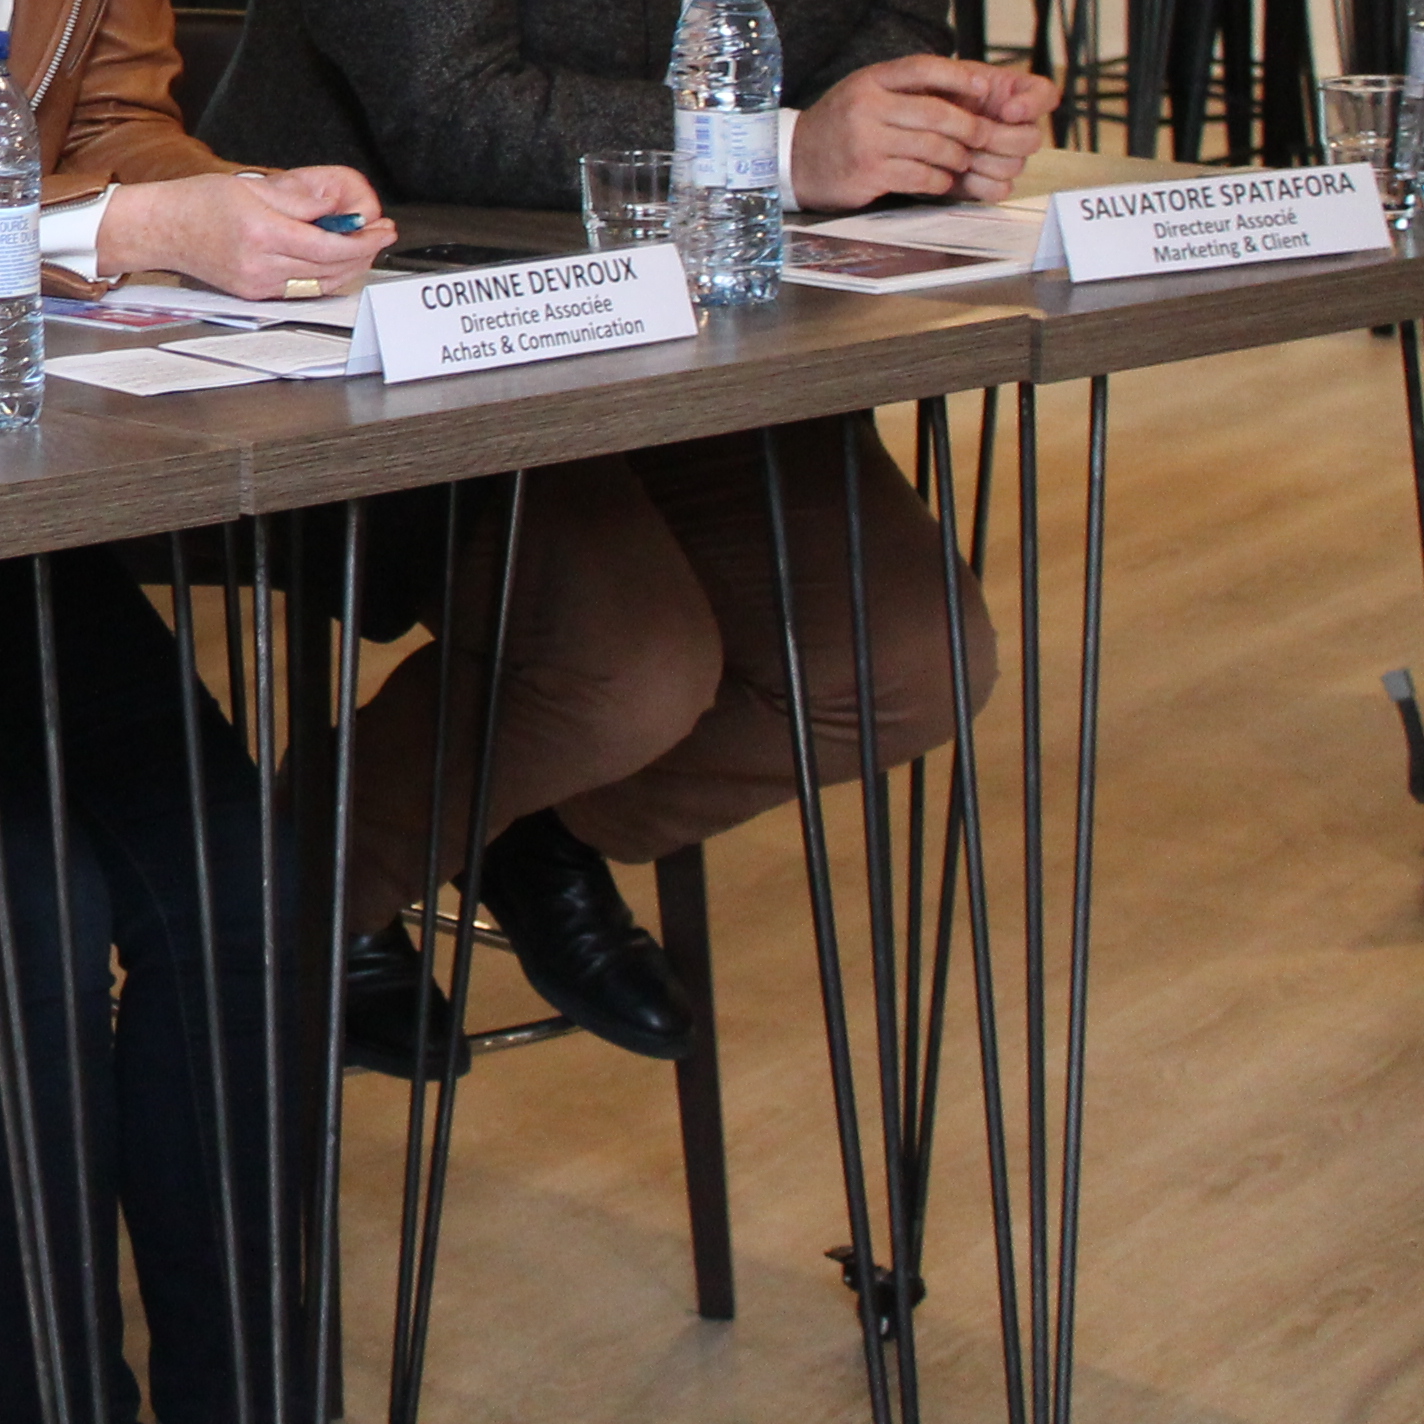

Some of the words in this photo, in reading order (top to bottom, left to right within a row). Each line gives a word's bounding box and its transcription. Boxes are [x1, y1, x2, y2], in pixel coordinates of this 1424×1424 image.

[1080, 186, 1214, 222] SALVATORE
[1221, 172, 1356, 207] SPATAFORA
[1153, 215, 1231, 240] Directeur
[1236, 207, 1298, 231] Associé
[1153, 237, 1240, 263] Marketing
[1246, 235, 1258, 253] &
[1261, 230, 1311, 250] Client
[421, 273, 523, 310] CORINNE
[529, 256, 638, 295] DEVROUX
[460, 307, 540, 334] Directrice
[545, 294, 614, 322] Associée
[441, 342, 497, 364] Achats
[502, 335, 514, 354] &
[518, 316, 645, 352] Communication
